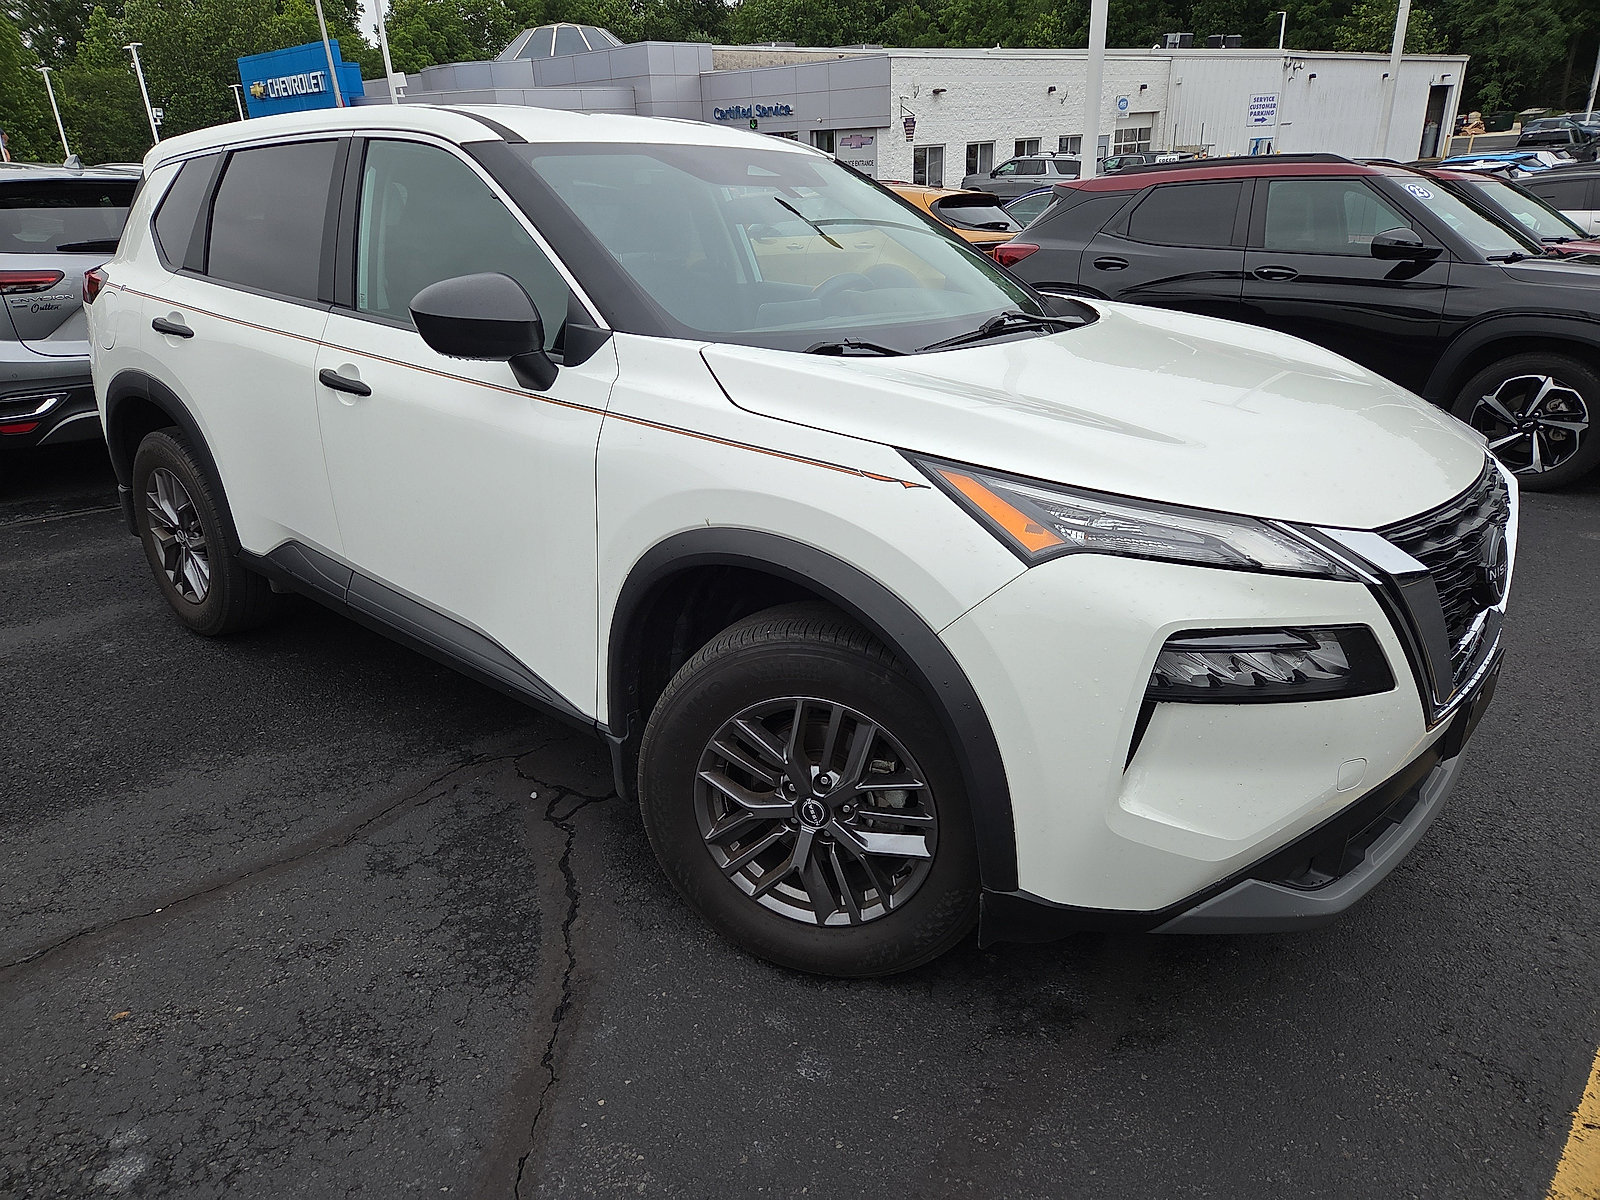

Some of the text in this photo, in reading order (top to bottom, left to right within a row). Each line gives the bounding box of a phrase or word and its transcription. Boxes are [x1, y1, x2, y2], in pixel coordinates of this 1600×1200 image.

[267, 71, 325, 98] CHEVROLET
[713, 103, 793, 120] Certified Service
[10, 294, 75, 304] ENVISION
[806, 798, 820, 826] NISSAN
